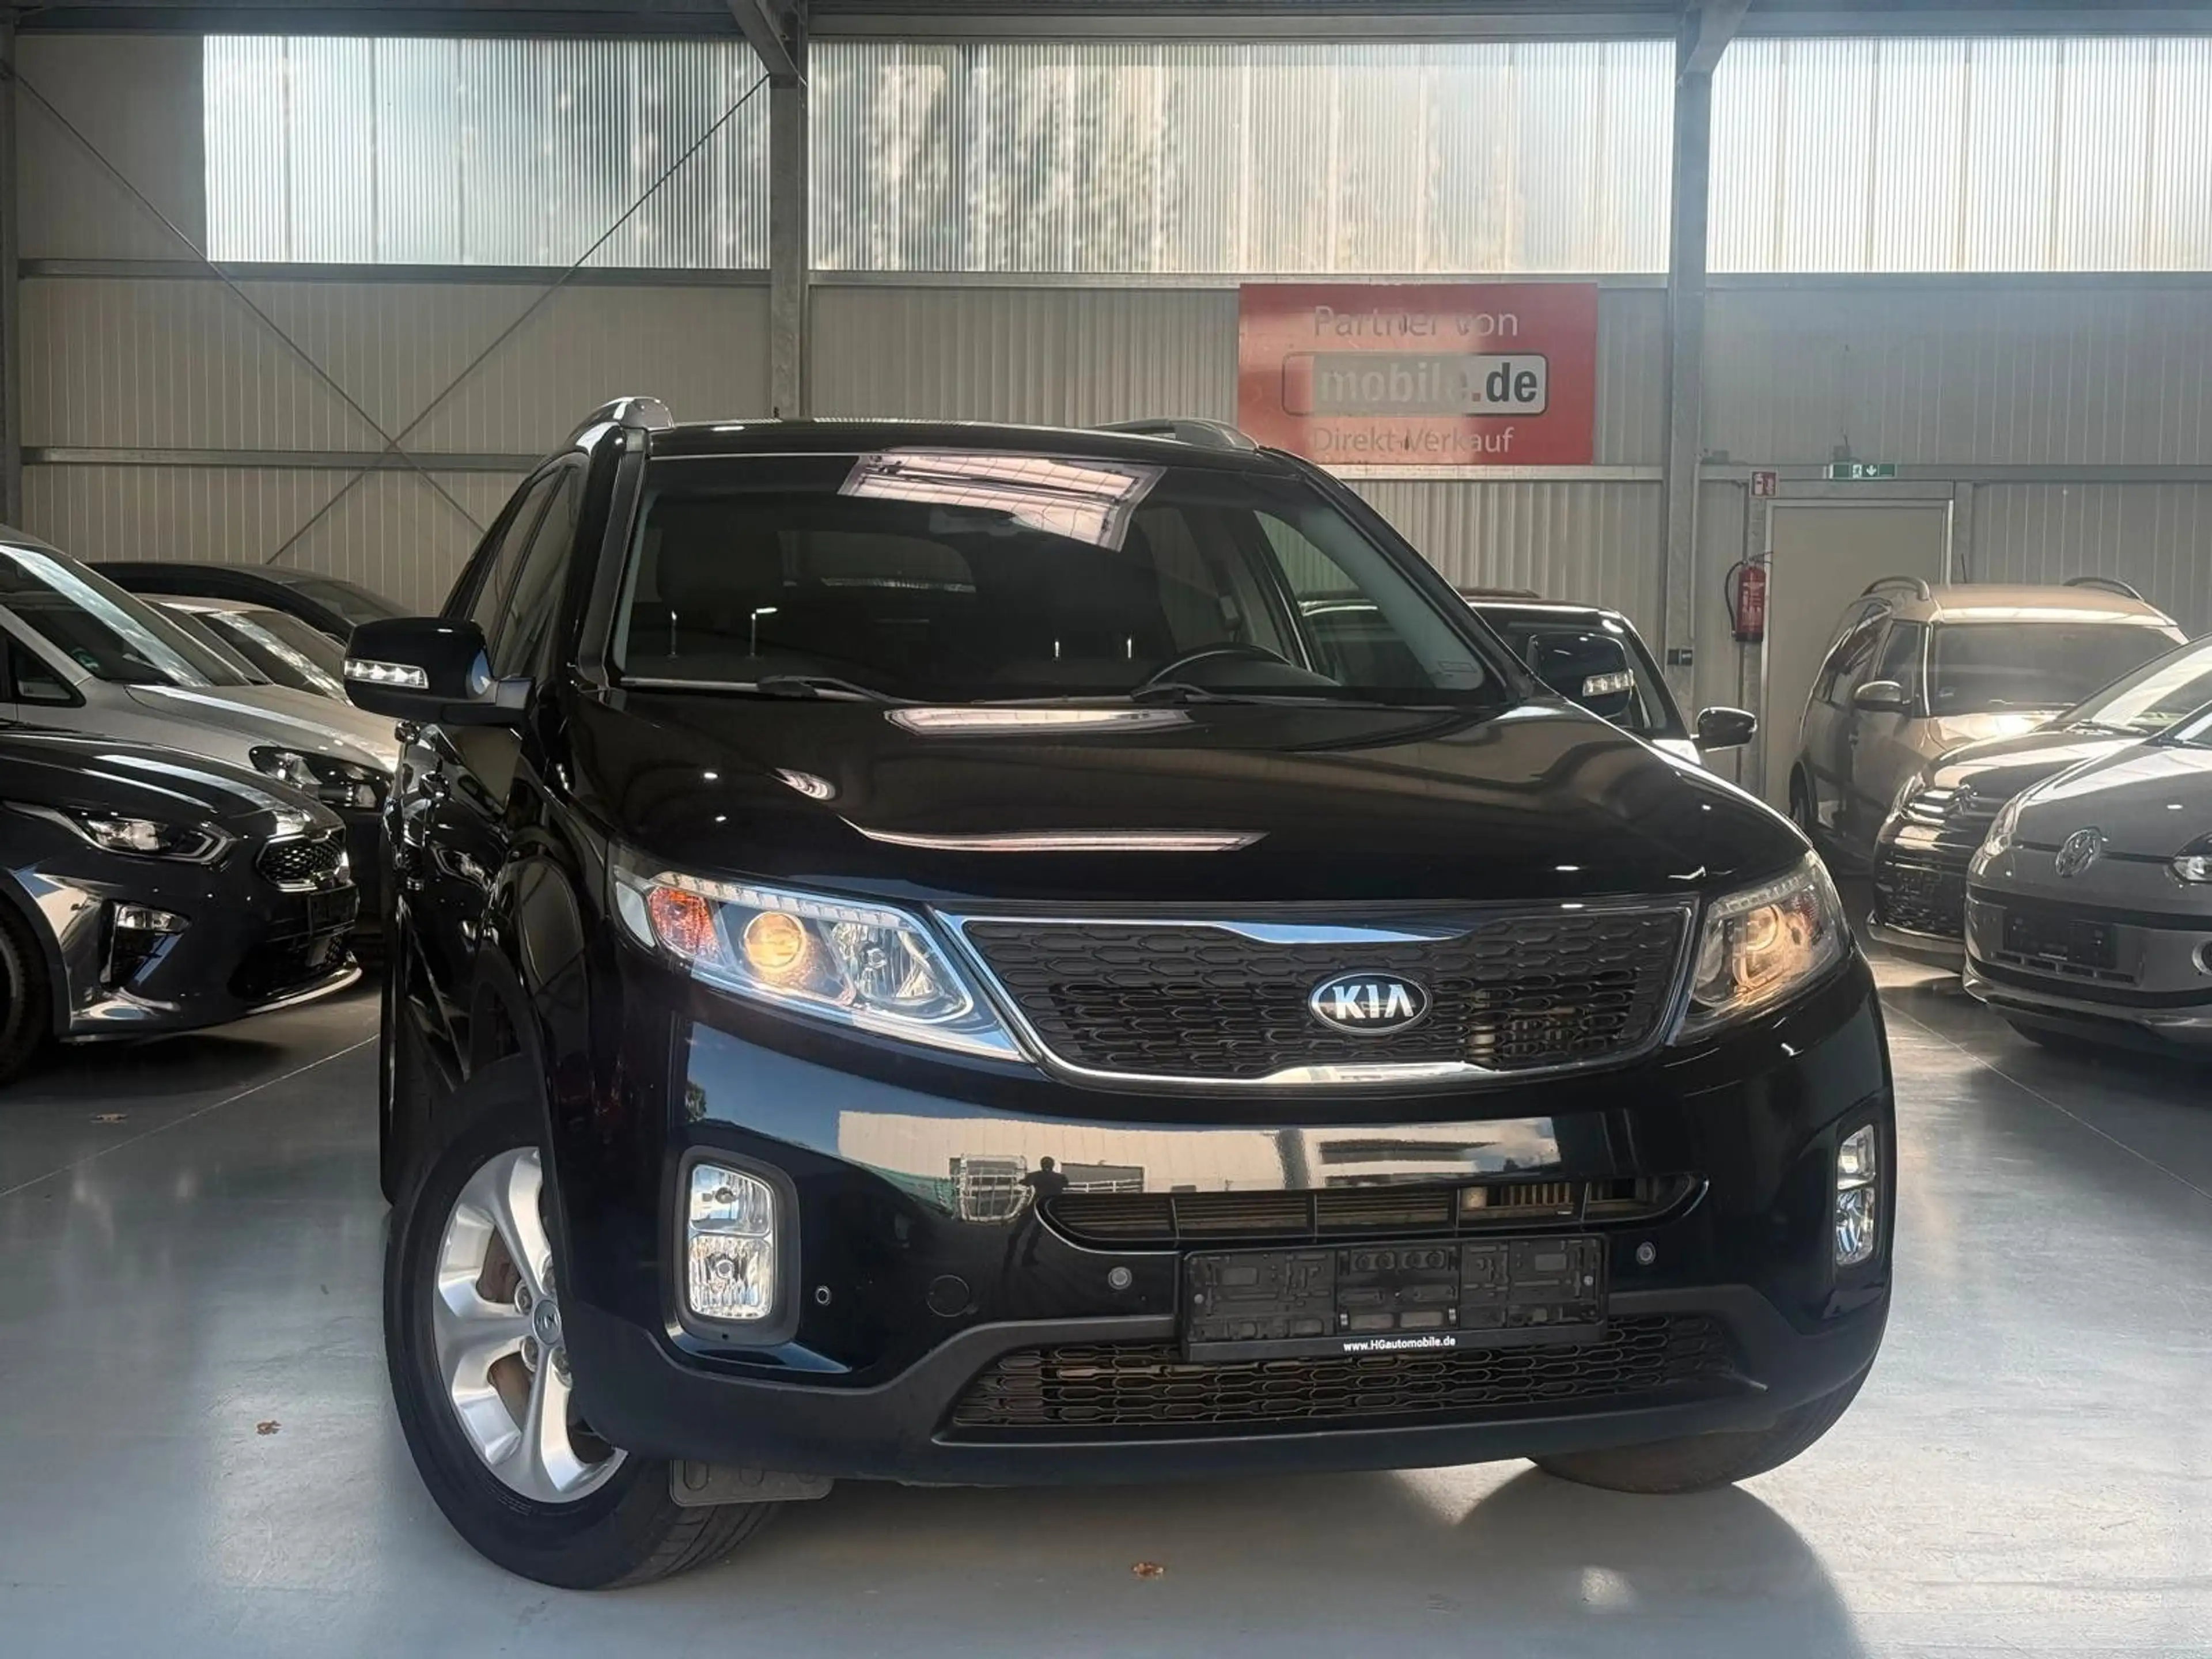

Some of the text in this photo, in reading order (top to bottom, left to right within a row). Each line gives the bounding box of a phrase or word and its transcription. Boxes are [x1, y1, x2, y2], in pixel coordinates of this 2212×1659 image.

[1314, 305, 1518, 338] Partner von
[1321, 362, 1537, 403] mobile.de
[1332, 984, 1414, 1020] KIA
[1343, 1335, 1456, 1351] www.HGautomobile.de
